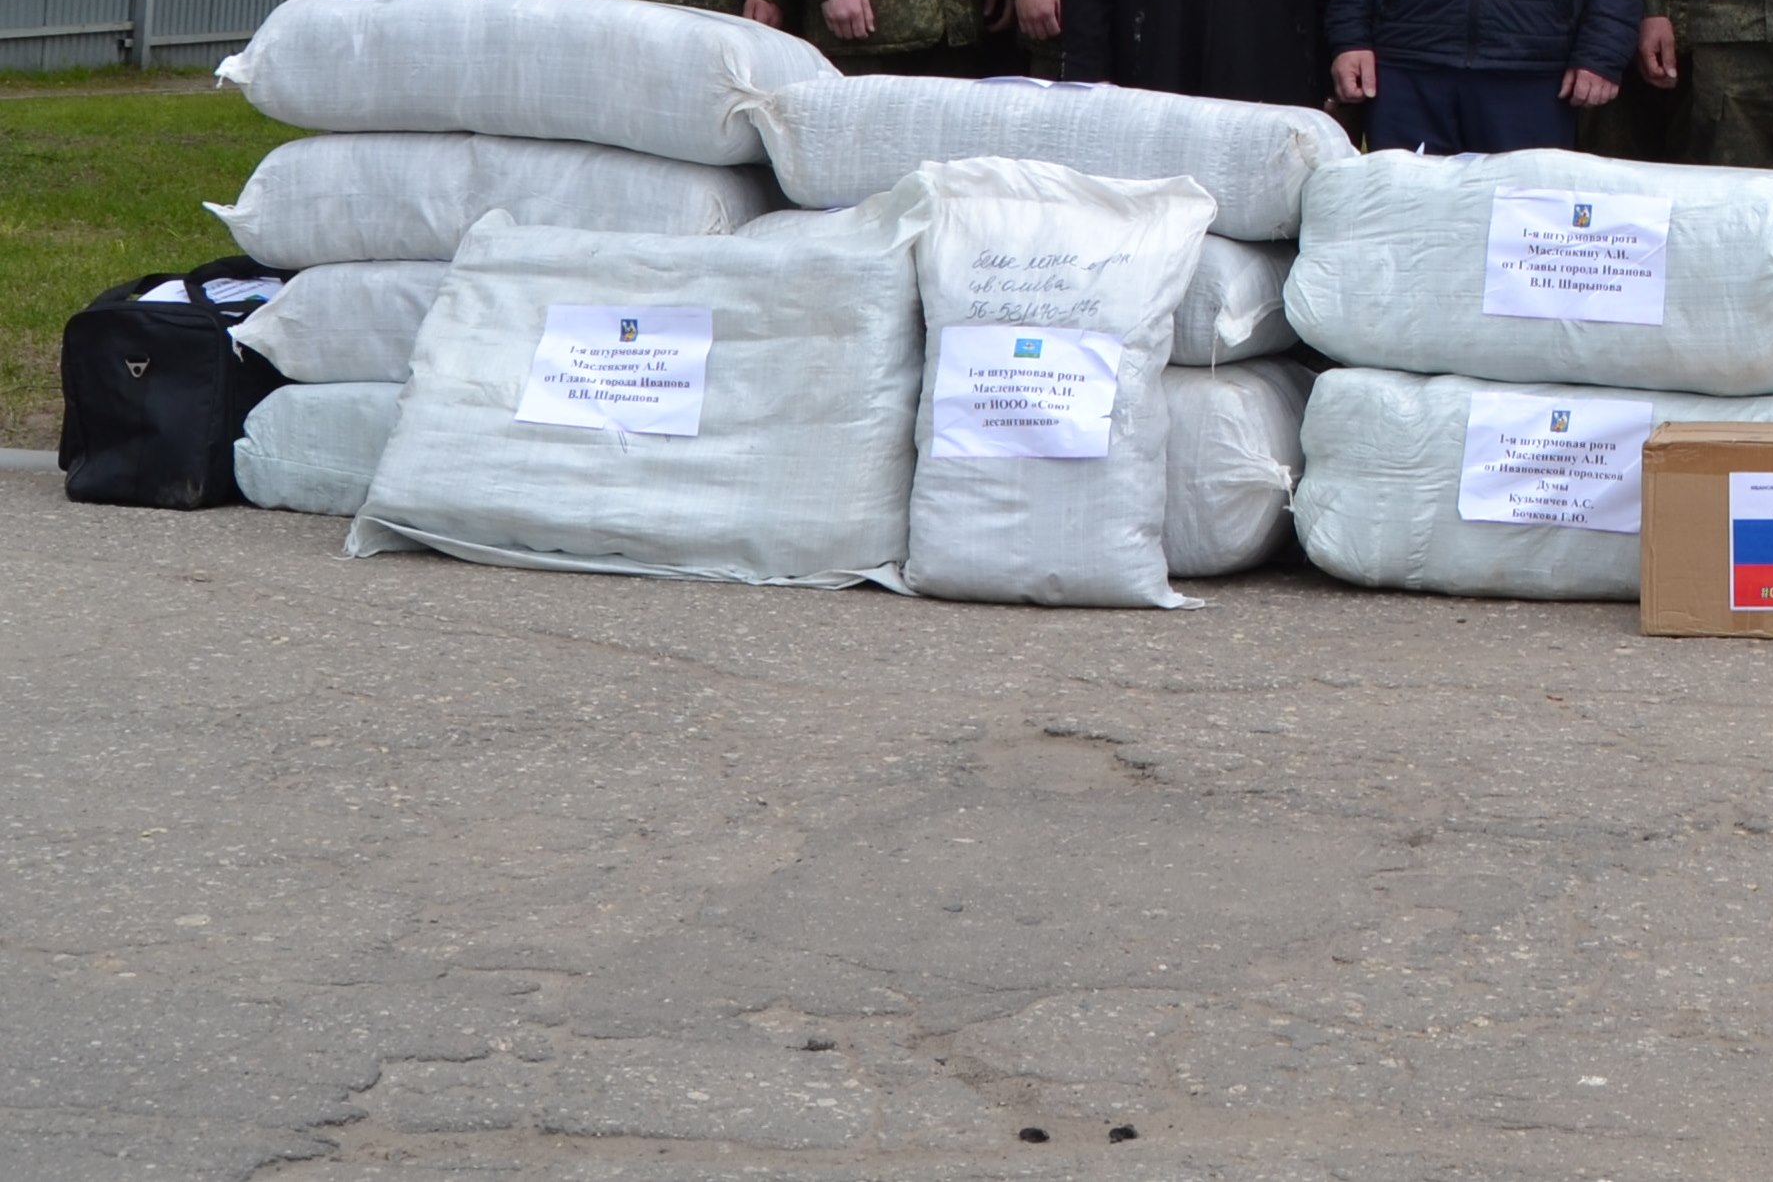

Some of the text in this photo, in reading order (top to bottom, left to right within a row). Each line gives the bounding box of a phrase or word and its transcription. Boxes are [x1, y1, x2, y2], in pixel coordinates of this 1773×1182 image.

[1523, 228, 1638, 246] 1-я штурмовая рота
[1502, 260, 1652, 278] от Главы города Иванова
[1558, 278, 1623, 294] Шарыпова
[570, 345, 679, 359] 1-я штурмовая рота
[544, 372, 690, 388] от Главы города Иванова
[969, 367, 1085, 383] 1-я штурмовая рота
[594, 390, 660, 404] Шарыпова
[974, 398, 1070, 410] от ИООО «Союз
[982, 418, 1060, 428] десантников»
[1500, 433, 1617, 452] 1-я штурмовая рота
[1484, 463, 1624, 481] от Ивановской городской
[1536, 480, 1569, 492] Думы
[1508, 493, 1568, 507] Кузьмичев
[1512, 508, 1558, 522] Бочкова
